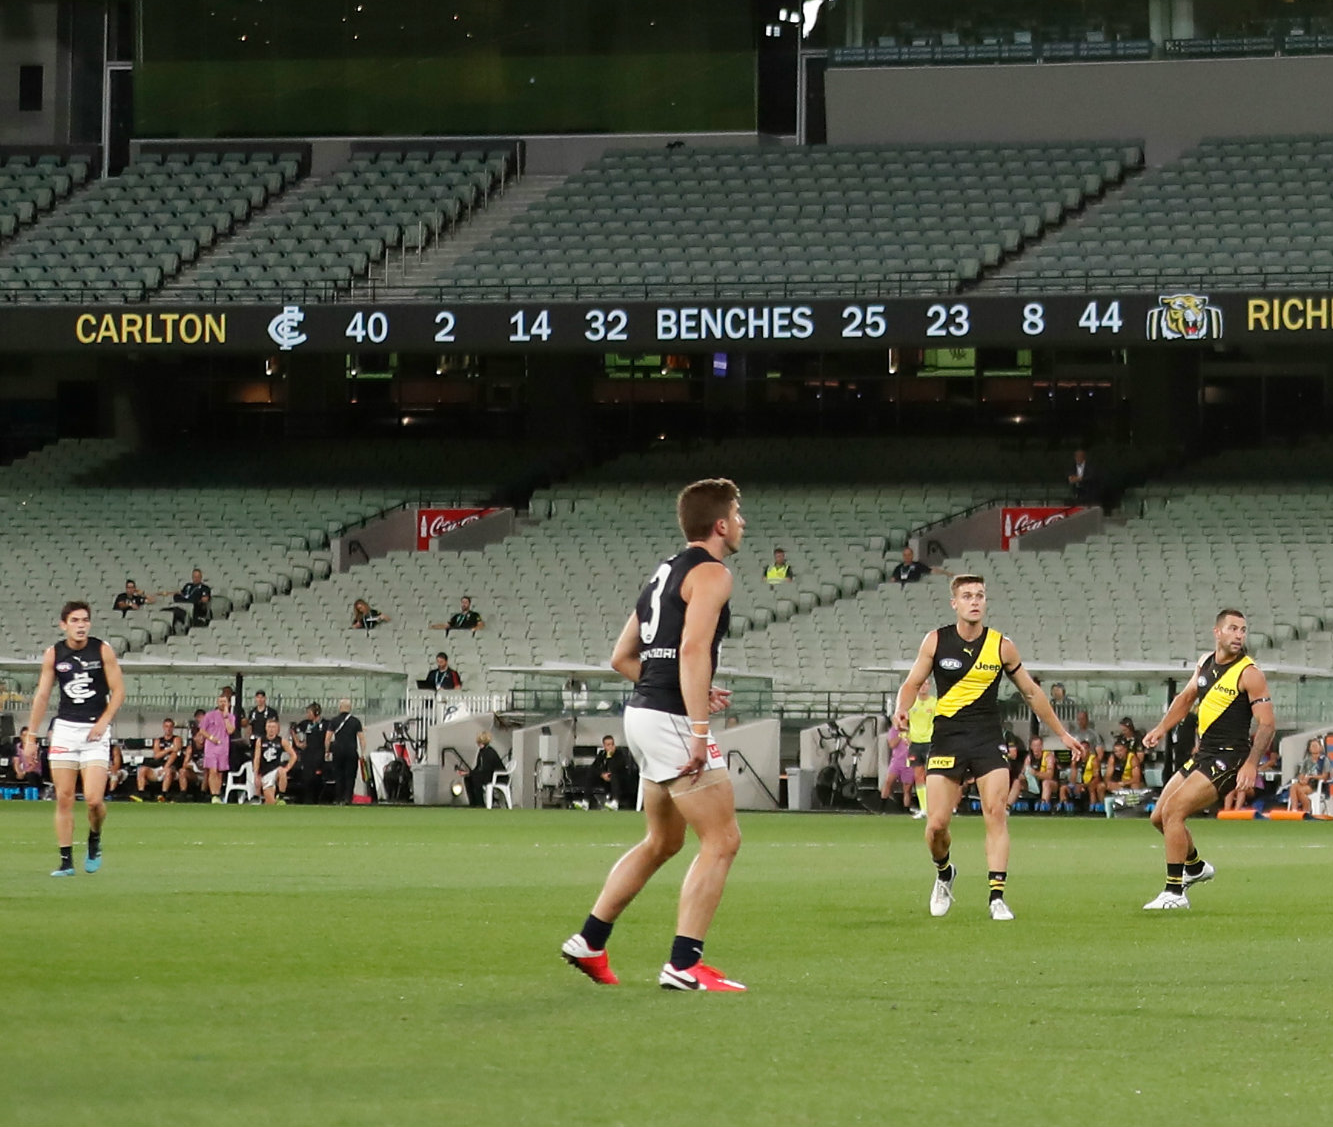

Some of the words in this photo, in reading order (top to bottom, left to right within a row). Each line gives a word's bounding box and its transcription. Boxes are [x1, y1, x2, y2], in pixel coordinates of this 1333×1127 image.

[76, 313, 226, 344] CARLTON
[345, 311, 388, 343] 40
[434, 311, 455, 342] 2
[509, 309, 552, 342] 14
[584, 309, 628, 341] 32
[656, 306, 814, 340] BENCHES
[841, 305, 887, 338] 25
[926, 303, 970, 337] 23
[1022, 302, 1045, 335] 8
[1078, 300, 1123, 334] 44
[640, 563, 672, 644] 3
[941, 659, 960, 669] AFL
[975, 661, 1000, 671] Jeep
[1214, 683, 1236, 697] Jeep
